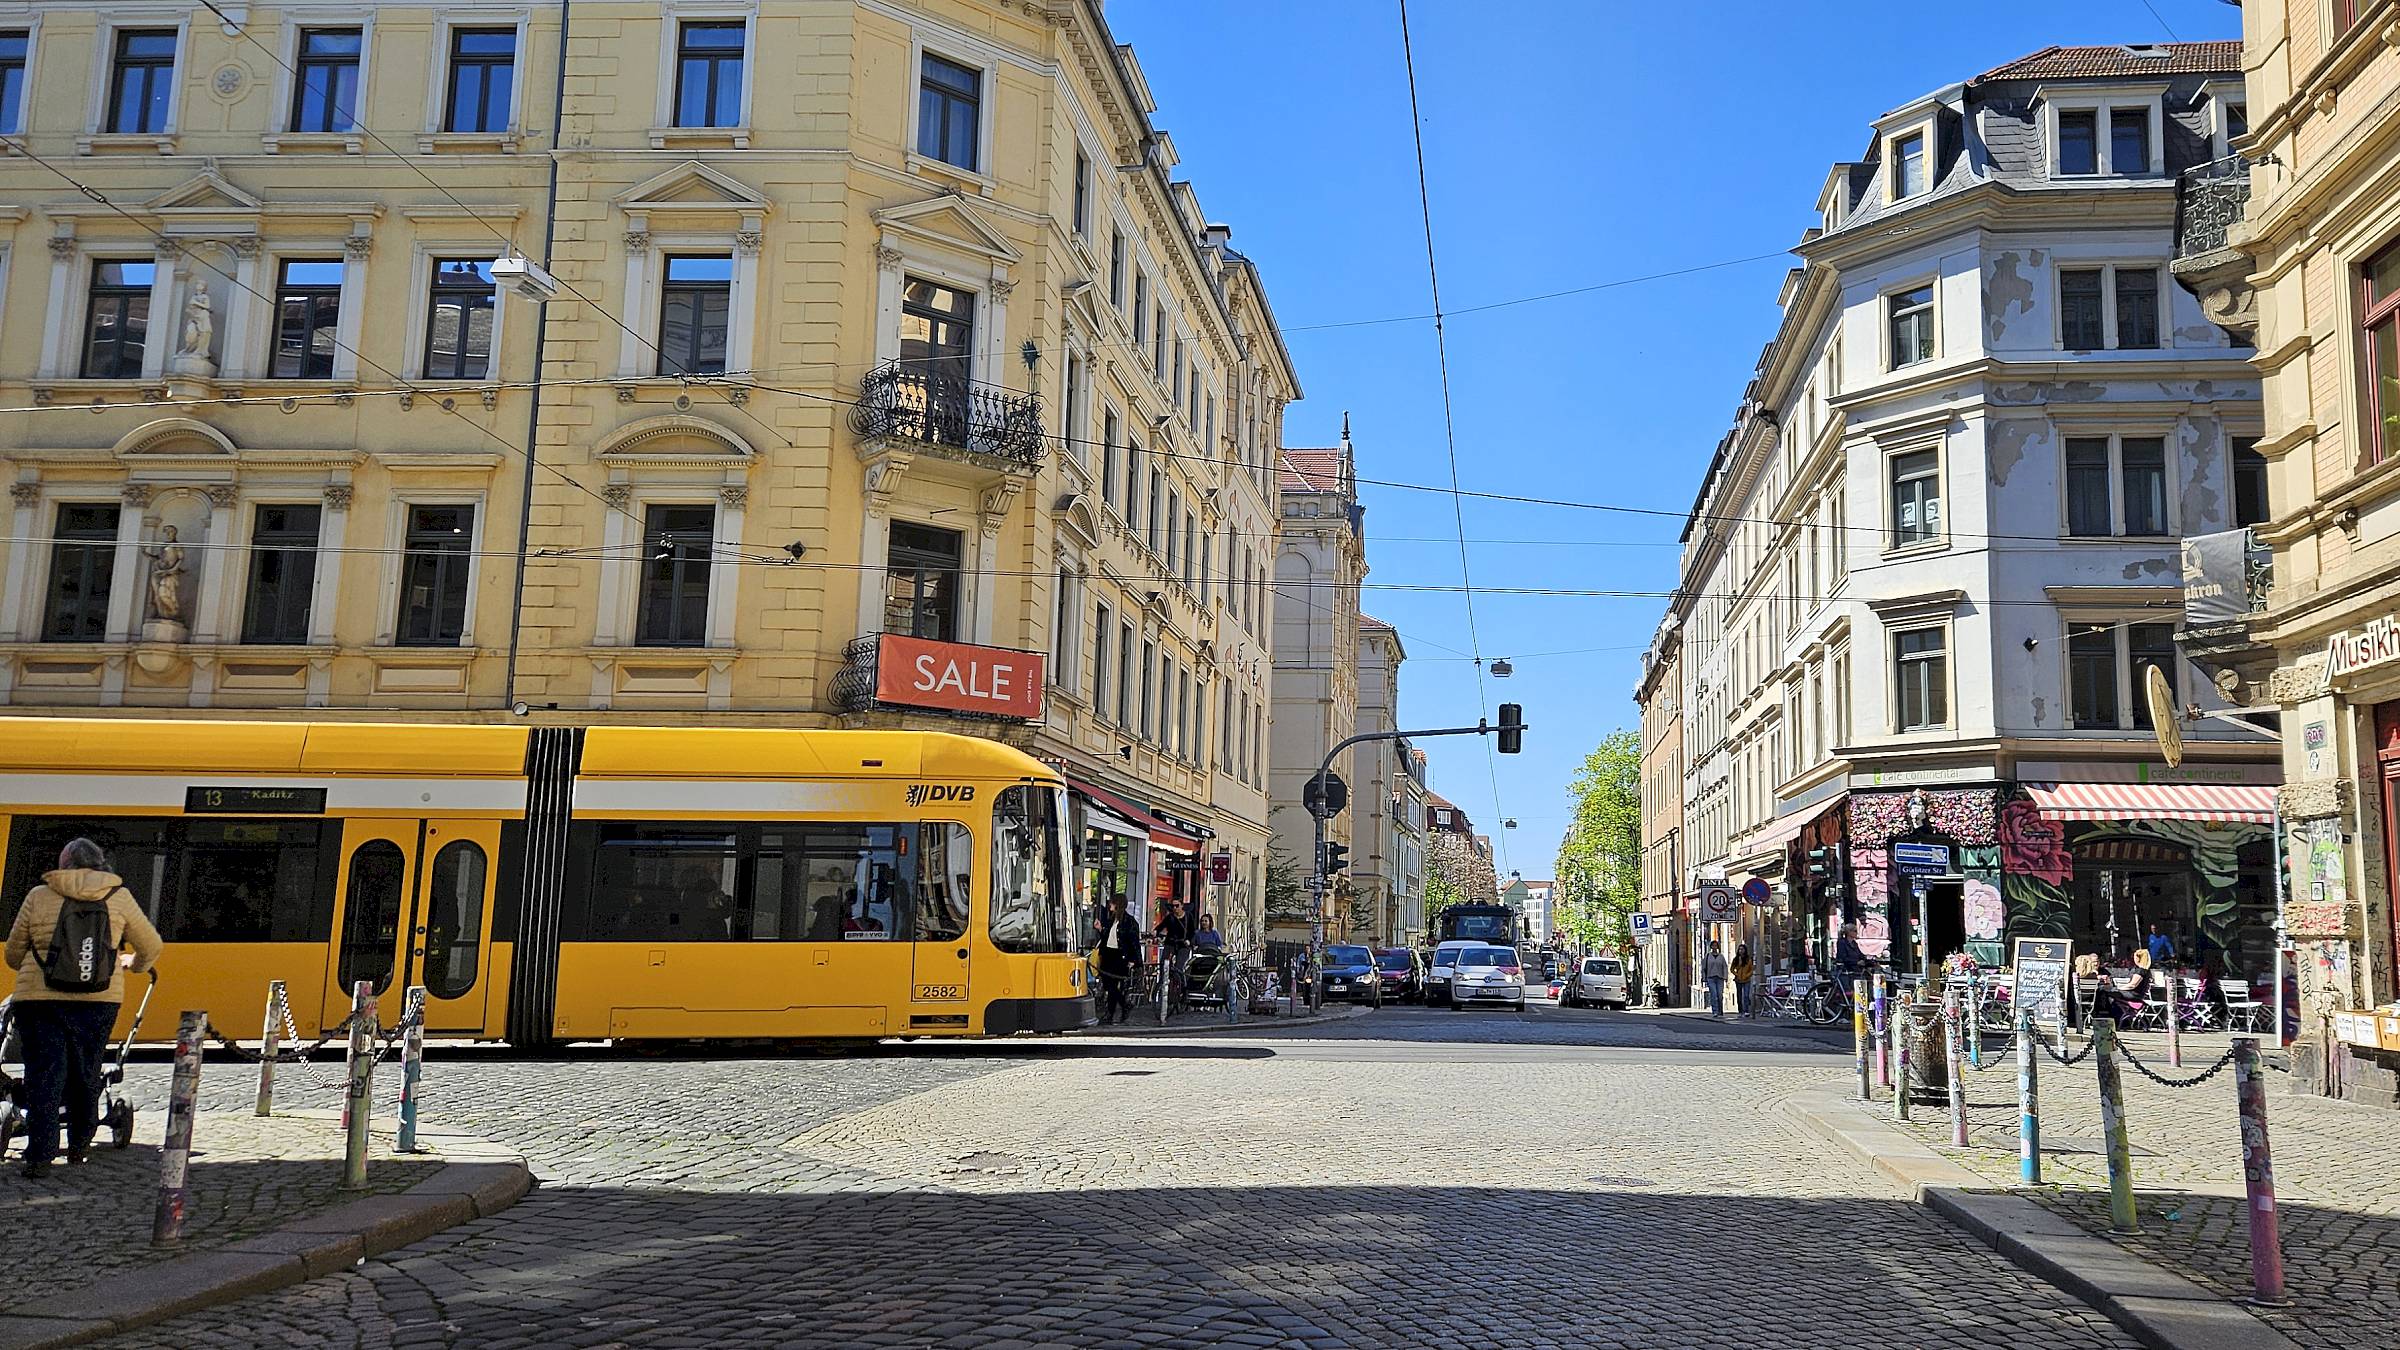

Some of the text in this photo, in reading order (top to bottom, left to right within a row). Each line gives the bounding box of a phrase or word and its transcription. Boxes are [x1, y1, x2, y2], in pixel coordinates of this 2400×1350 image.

[913, 654, 1012, 701] SALE
[1905, 769, 1959, 781] continental
[2181, 768, 2245, 780] continental
[205, 789, 295, 806] 13 Kaditz
[929, 785, 975, 802] DVB
[1712, 895, 1726, 906] 20
[1636, 916, 1645, 927] P
[79, 936, 93, 982] adidas
[922, 986, 958, 998] 2582
